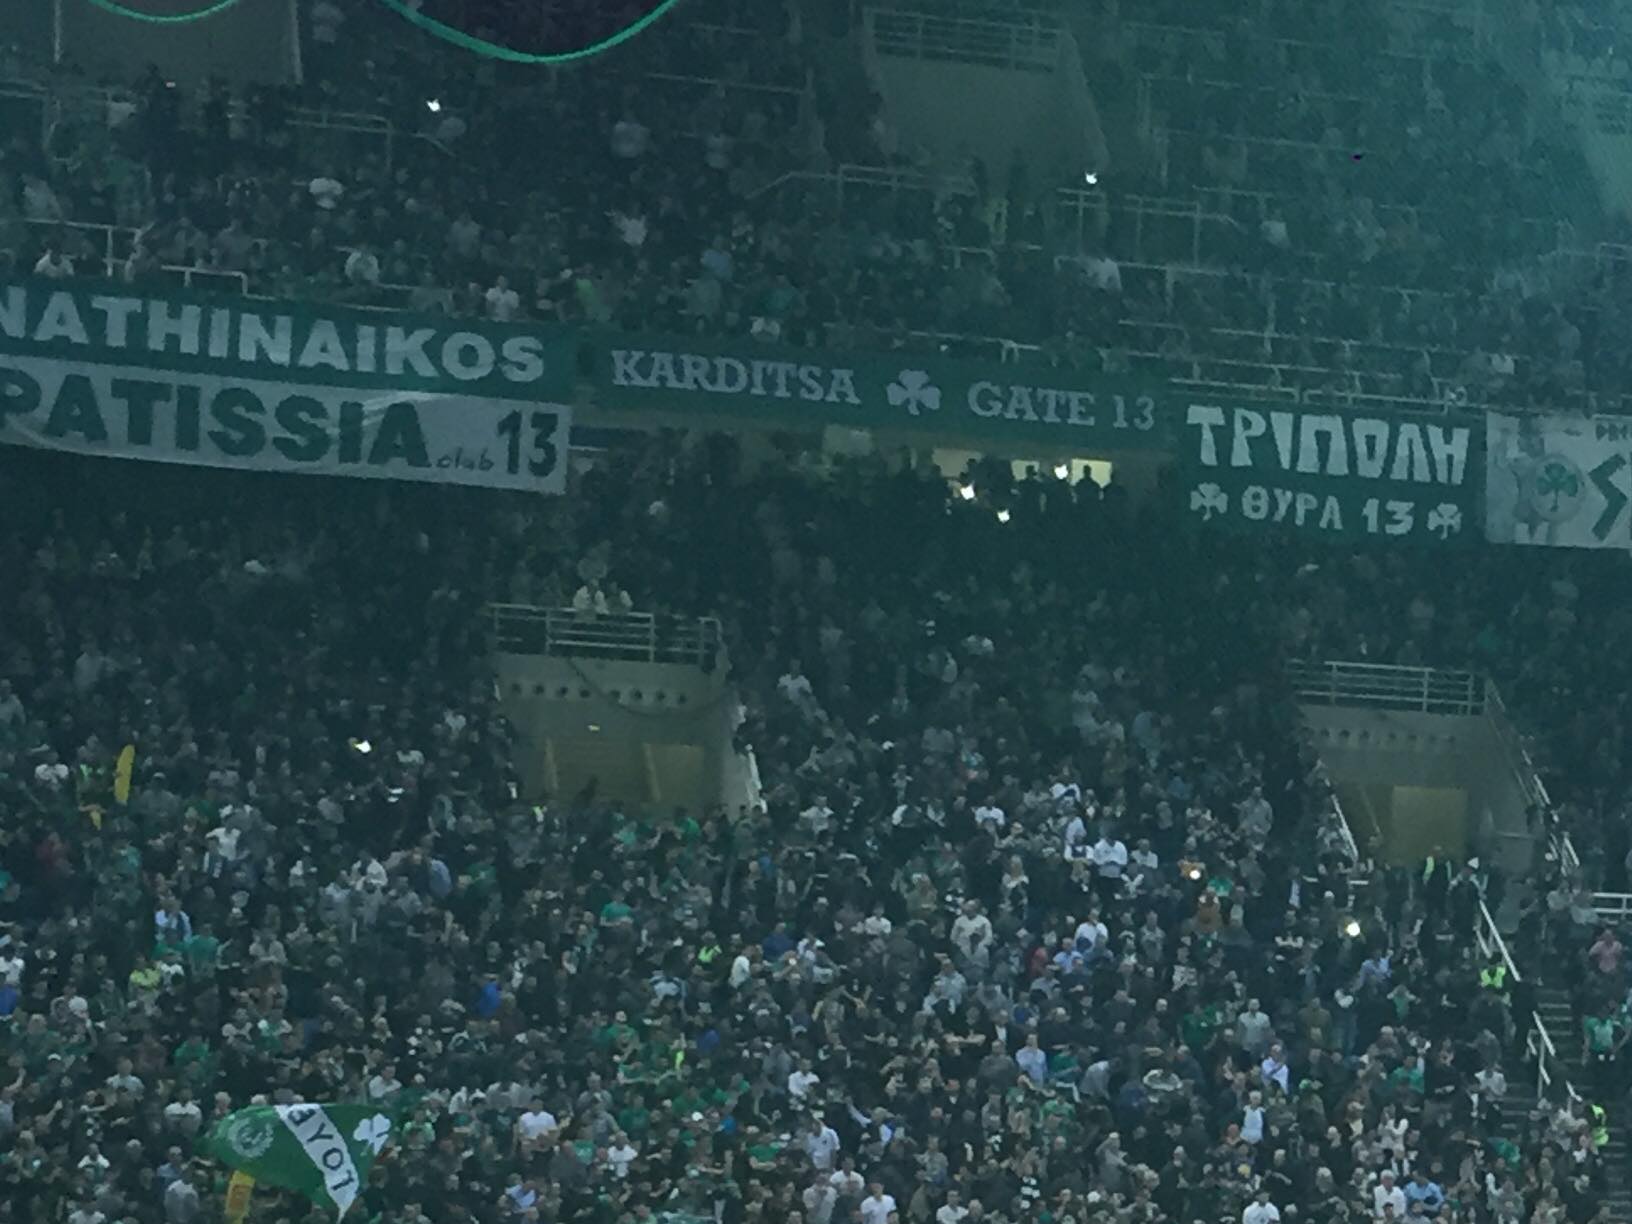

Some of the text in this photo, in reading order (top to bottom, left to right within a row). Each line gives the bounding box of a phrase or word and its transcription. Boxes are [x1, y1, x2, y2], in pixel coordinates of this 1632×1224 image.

[0, 366, 432, 468] PATISSIA
[497, 409, 559, 478] 13
[611, 350, 1155, 431] KARDITSA GATE 13
[1241, 485, 1415, 536] ΘΥΡΑ 13
